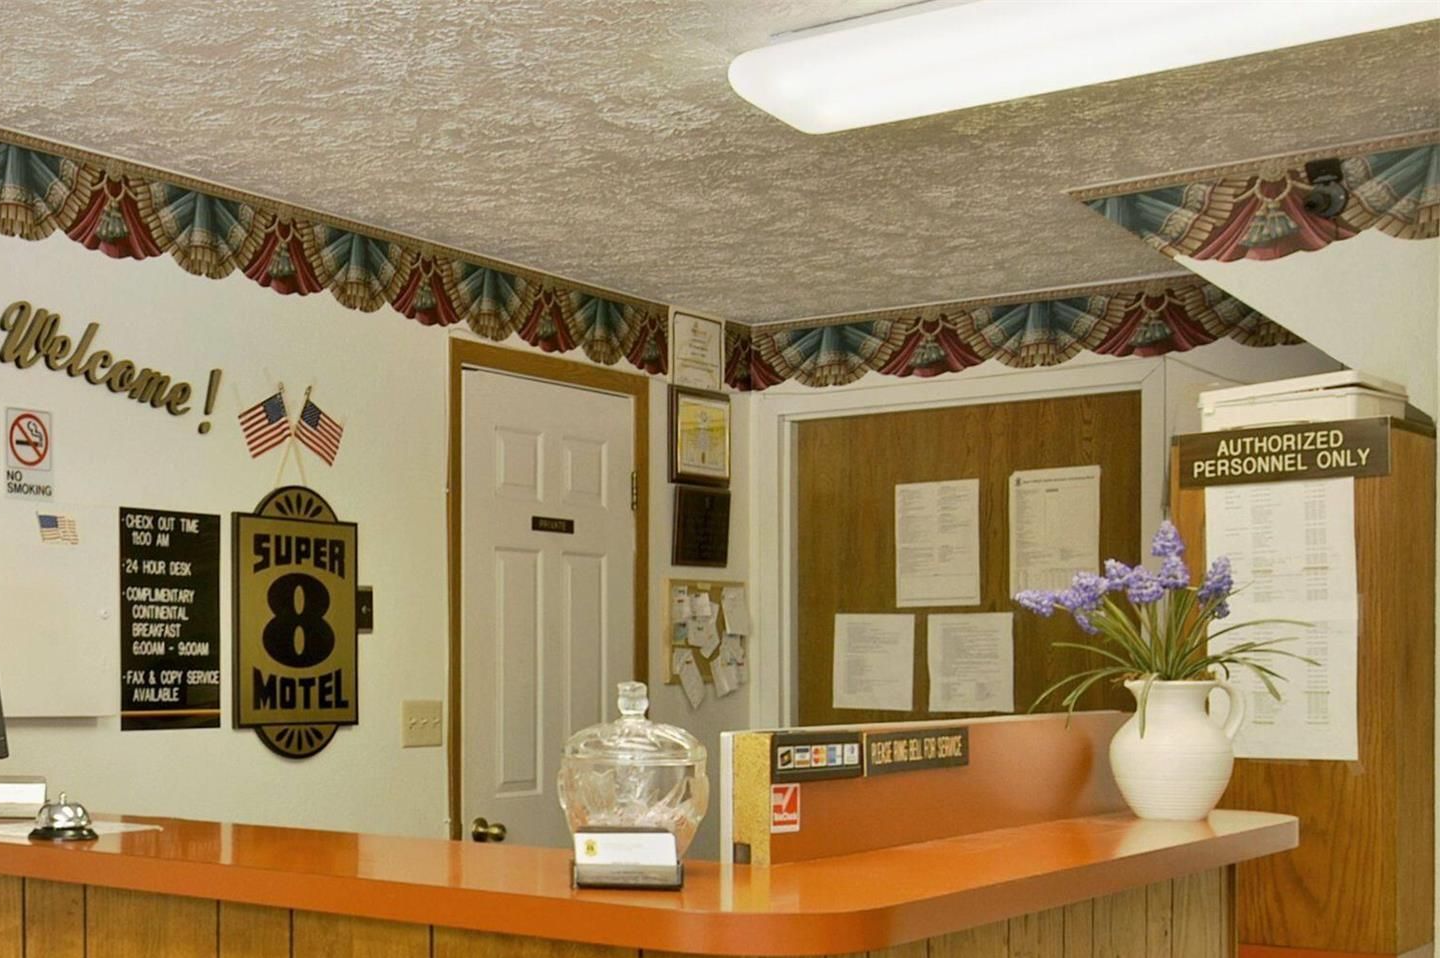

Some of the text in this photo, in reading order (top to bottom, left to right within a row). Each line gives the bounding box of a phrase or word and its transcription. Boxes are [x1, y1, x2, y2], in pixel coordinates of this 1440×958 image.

[0, 300, 223, 435] Welcome!
[1216, 429, 1344, 457] AUTHORIZED
[1192, 447, 1371, 479] PERSONNEL ONLY
[6, 470, 24, 483] NO
[6, 482, 53, 498] SMOKING
[125, 513, 201, 534] CHECK OUT TIME
[155, 532, 171, 548] AM
[253, 533, 347, 580] SUPER
[125, 558, 192, 577] 24 HOUR DESK
[132, 603, 190, 621] CONTINENTAL
[262, 572, 336, 669] 8
[131, 621, 181, 638] BREAKFAST
[126, 669, 220, 685] FAX & COPY SERVICE
[132, 686, 181, 702] AVAILABLE
[252, 667, 350, 711] MOTEL
[871, 741, 893, 764] PLEASE
[924, 737, 937, 759] FOR
[937, 735, 962, 758] SERVICE
